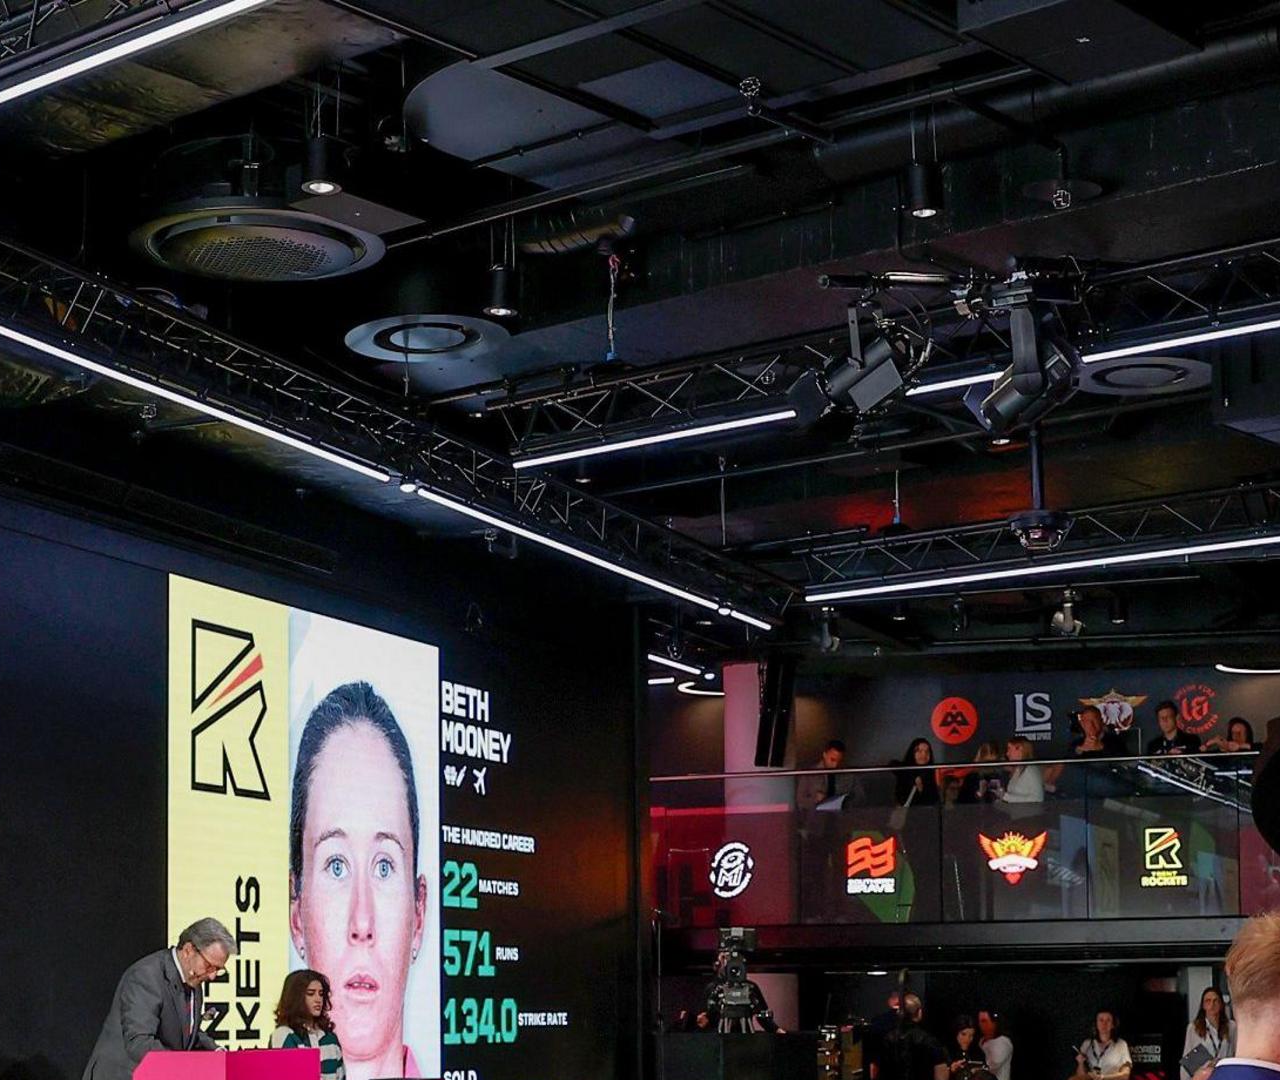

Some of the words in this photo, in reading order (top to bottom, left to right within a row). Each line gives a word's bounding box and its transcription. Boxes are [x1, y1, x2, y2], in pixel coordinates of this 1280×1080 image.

[442, 681, 489, 722] BETH
[1014, 693, 1053, 732] LS
[442, 719, 511, 763] MOONEY
[442, 825, 461, 844] THE
[461, 828, 501, 849] HUNDRED
[502, 834, 535, 853] CAREER
[443, 860, 478, 909] 22
[478, 879, 519, 896] MATCHES
[236, 876, 260, 1050] KETS
[443, 929, 495, 977] 571
[495, 947, 519, 961] RUNS
[444, 997, 517, 1045] 134.0
[518, 1013, 546, 1026] STRIKE
[547, 1012, 568, 1025] RATE
